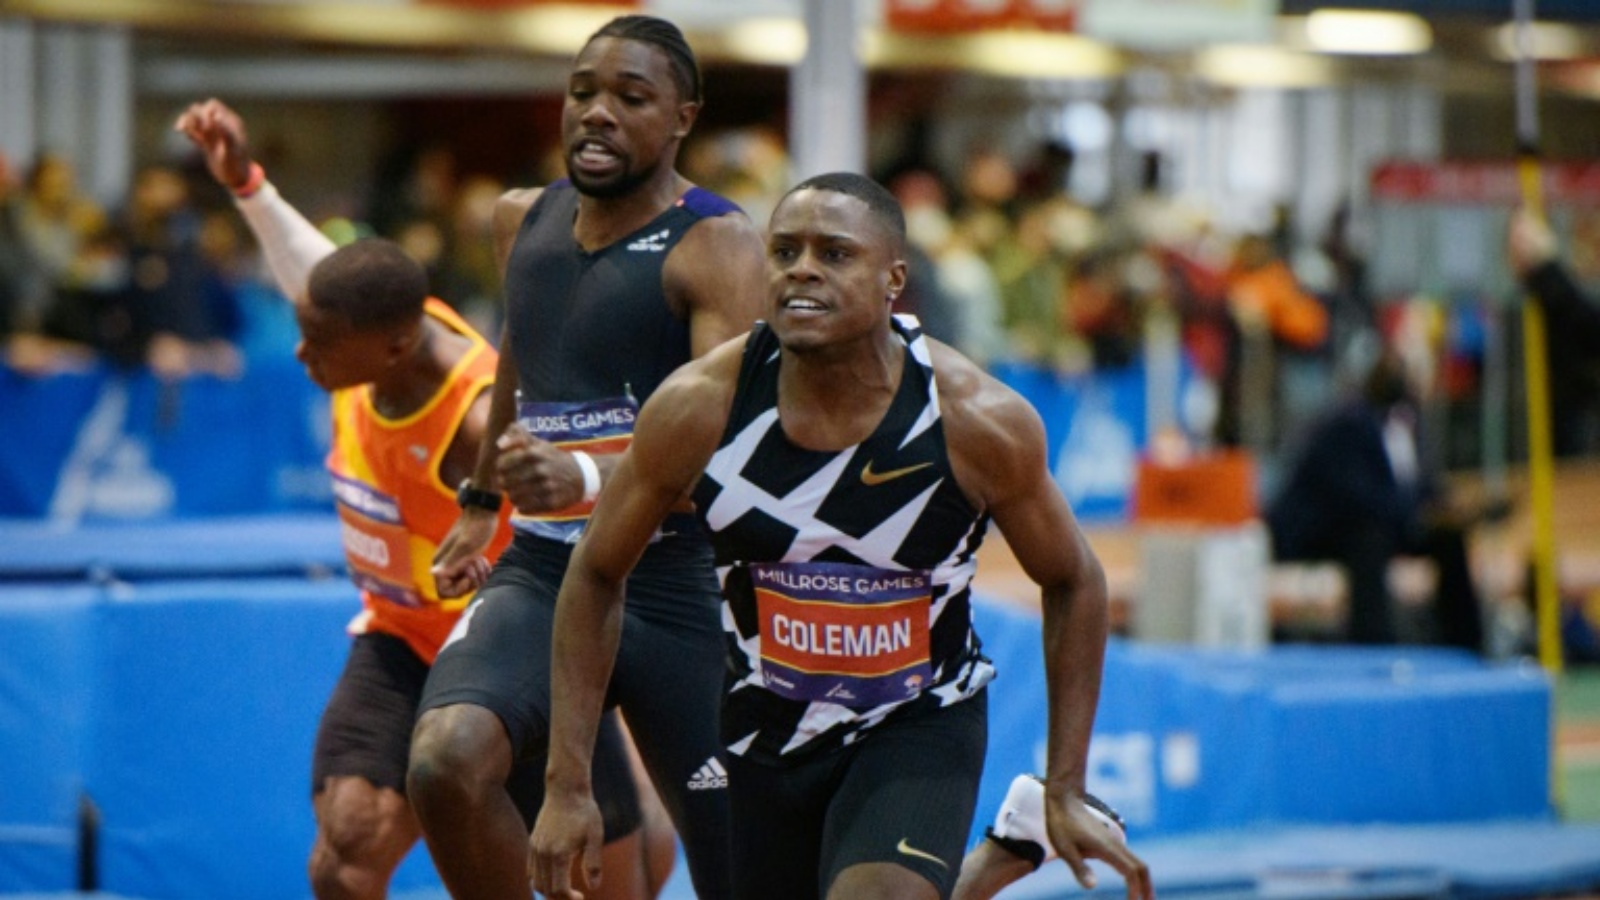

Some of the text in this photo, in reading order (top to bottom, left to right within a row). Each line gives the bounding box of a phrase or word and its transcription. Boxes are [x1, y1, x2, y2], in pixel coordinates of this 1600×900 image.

[572, 408, 635, 430] GAMES
[757, 568, 924, 594] MILLROSE GAMES
[773, 613, 912, 657] COLEMAN
